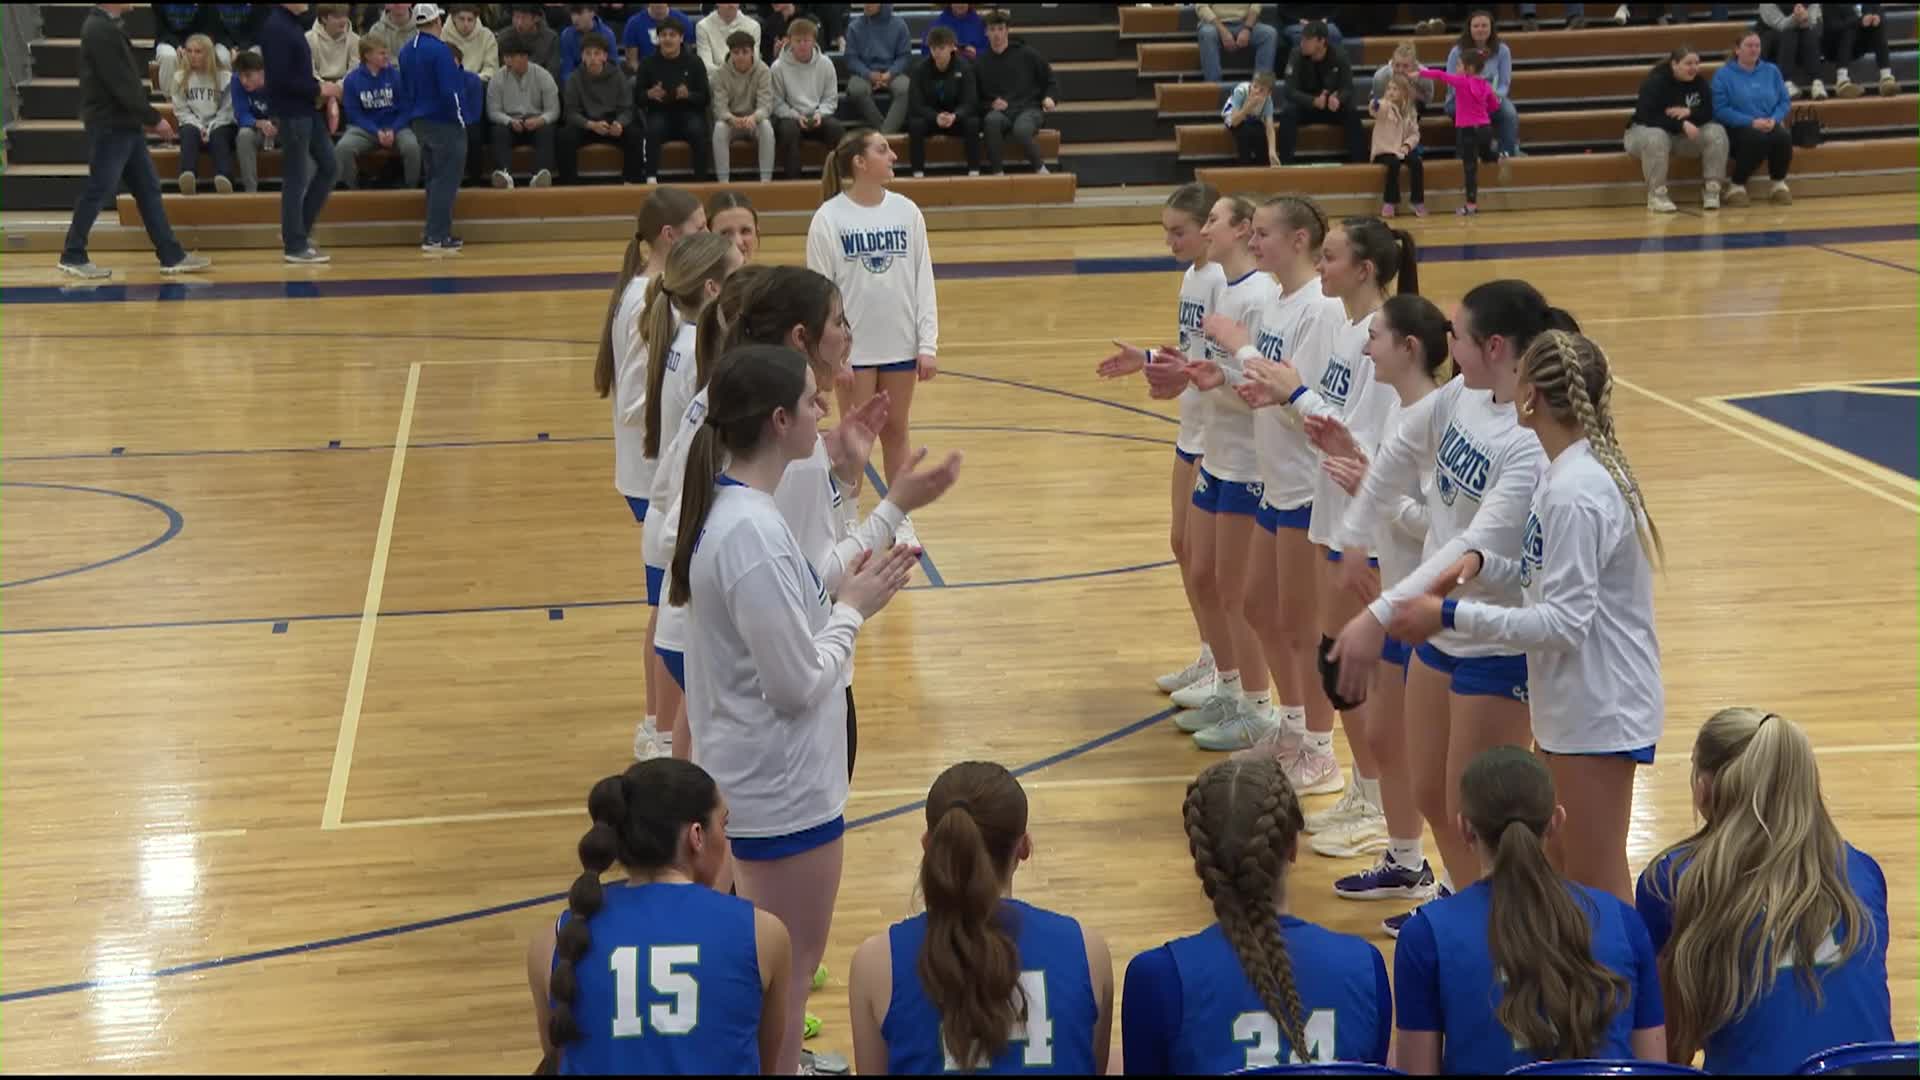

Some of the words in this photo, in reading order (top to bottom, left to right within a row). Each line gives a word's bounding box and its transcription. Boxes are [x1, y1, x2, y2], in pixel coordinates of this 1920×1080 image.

[184, 88, 206, 101] AVY
[841, 231, 907, 255] WILDCATS
[608, 944, 700, 1039] 15
[940, 969, 1054, 1070] 4
[1232, 1008, 1335, 1070] 34
